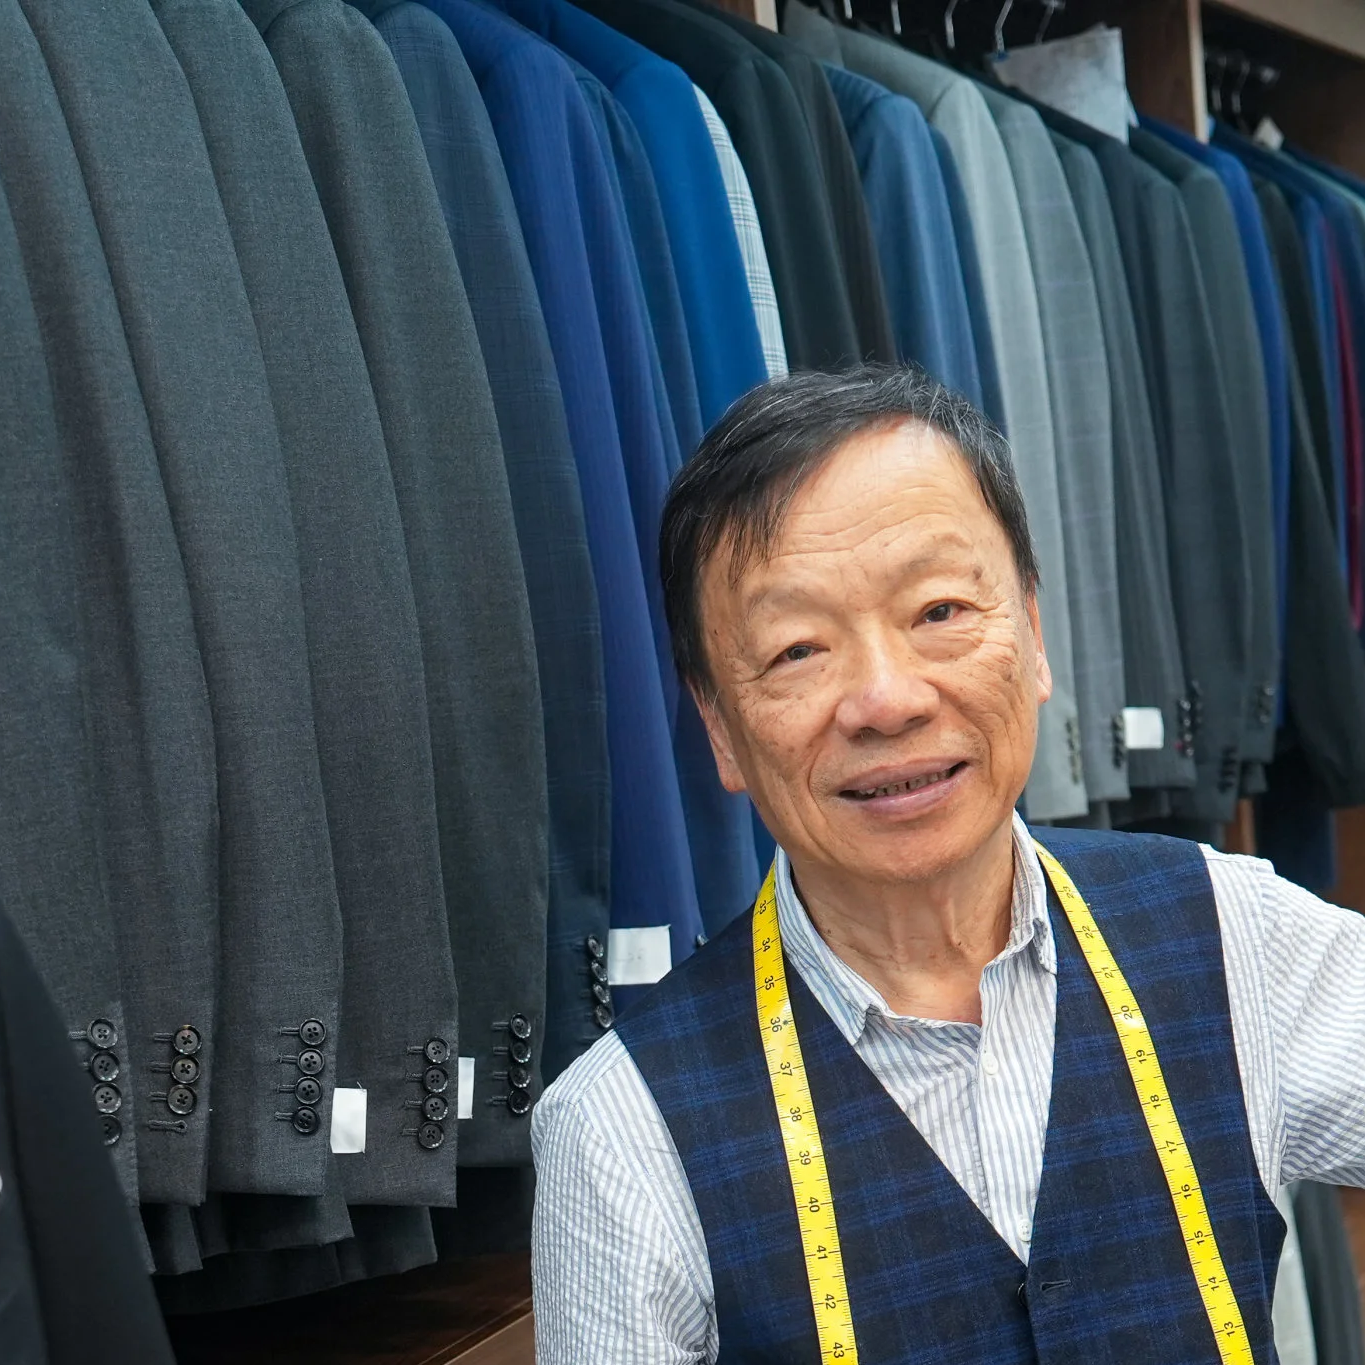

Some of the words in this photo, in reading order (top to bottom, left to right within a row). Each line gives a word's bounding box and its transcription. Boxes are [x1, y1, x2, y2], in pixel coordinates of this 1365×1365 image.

[1062, 886, 1075, 898] 23
[759, 900, 767, 915] 33
[1082, 925, 1095, 939] 22
[762, 937, 771, 952] 34
[1101, 966, 1114, 979] 21
[764, 975, 774, 991] 35
[1121, 1005, 1133, 1020] 20
[770, 1016, 783, 1033] 36
[1136, 1049, 1147, 1065] 19
[780, 1062, 793, 1077] 37
[1150, 1094, 1162, 1110] 18
[789, 1106, 802, 1122] 38
[1165, 1140, 1177, 1154] 17
[799, 1150, 811, 1166] 39
[1181, 1183, 1192, 1200] 16
[808, 1196, 820, 1213] 40
[1194, 1230, 1205, 1246] 15
[816, 1245, 828, 1260] 41
[1208, 1276, 1219, 1292] 14
[824, 1293, 837, 1310] 42
[1223, 1321, 1235, 1338] 13
[833, 1341, 845, 1359] 43
